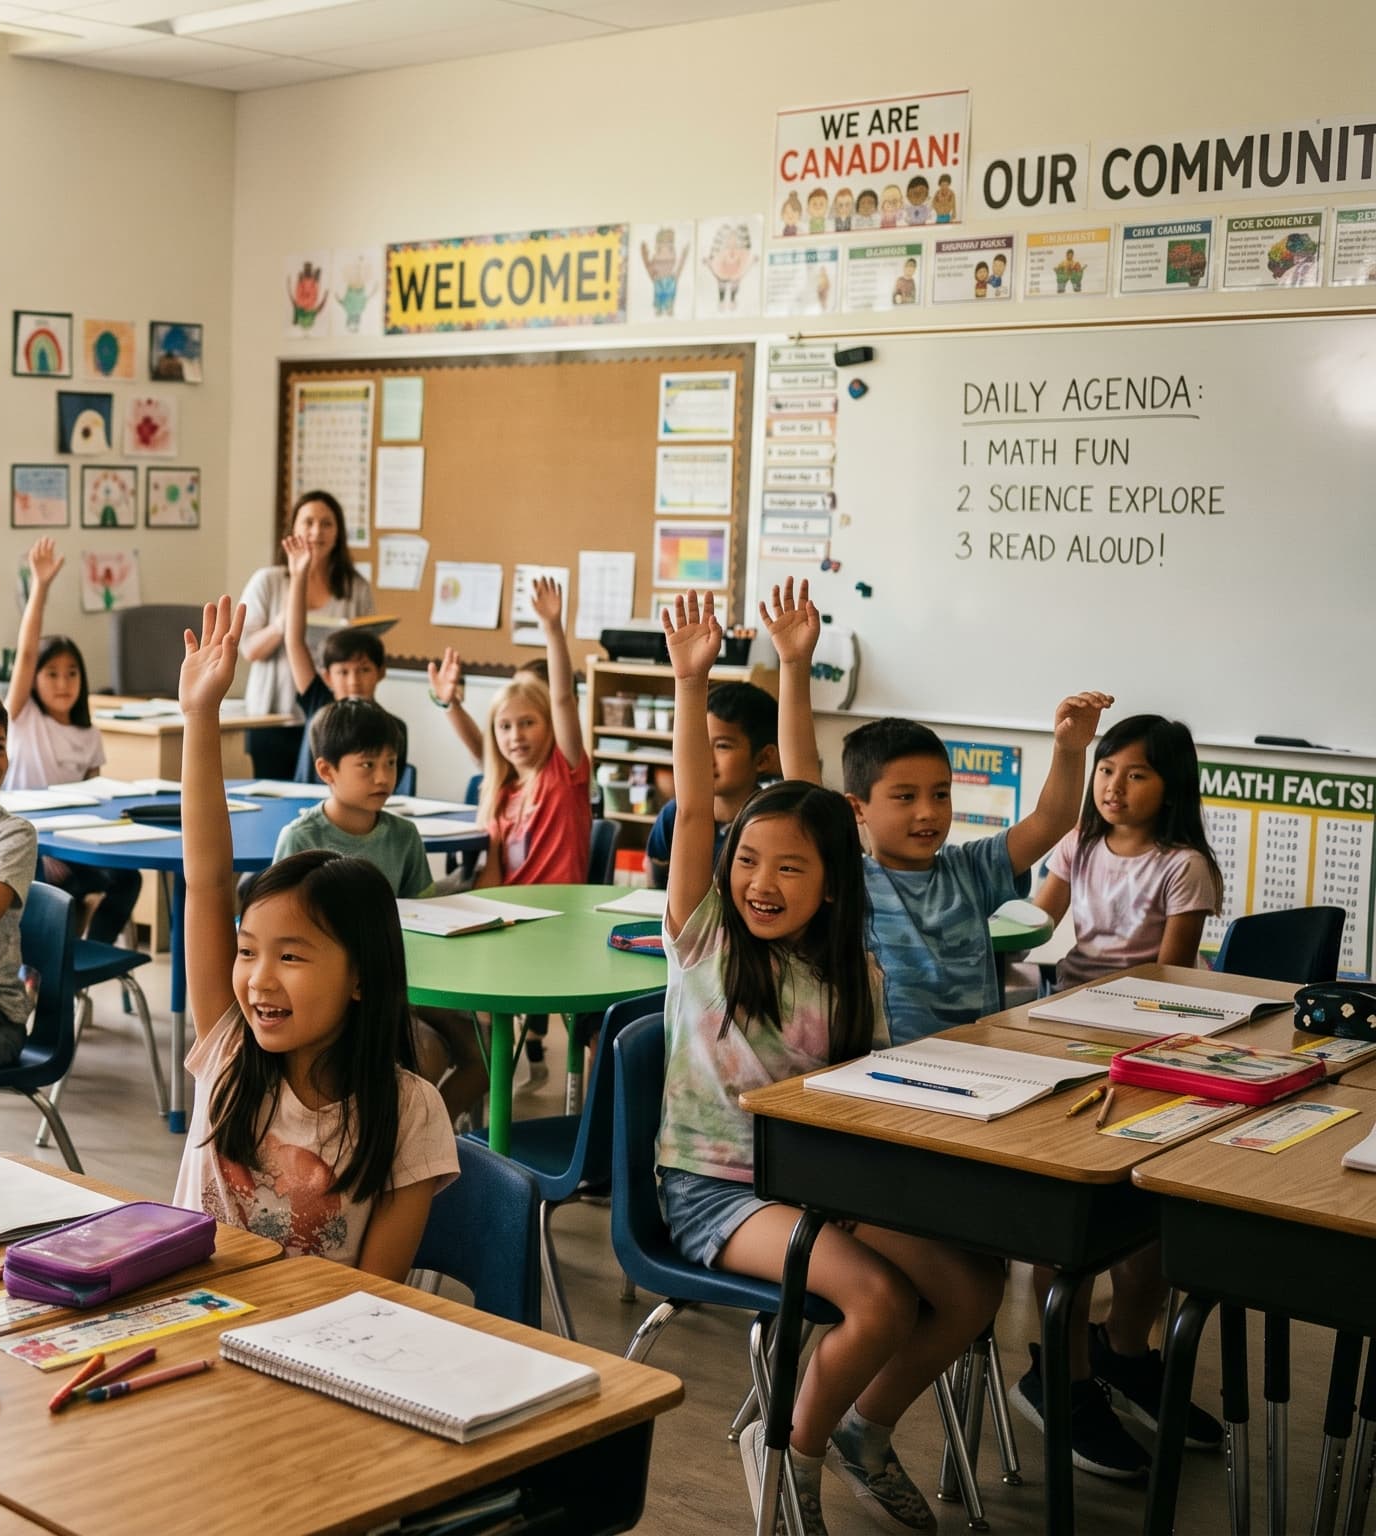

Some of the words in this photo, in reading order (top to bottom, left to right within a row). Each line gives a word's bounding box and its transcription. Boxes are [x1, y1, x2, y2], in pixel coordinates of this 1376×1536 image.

[820, 112, 860, 141] WE
[867, 104, 920, 136] ARE
[779, 132, 960, 182] CANADIAN!
[983, 153, 1077, 210] OUR
[1101, 123, 1376, 200] COMMUNIT
[395, 249, 613, 313] WELCOME!
[963, 380, 1047, 415] DAILY
[1062, 375, 1204, 412] AGENDA:
[987, 438, 1057, 466] MATH
[1075, 437, 1130, 466] FUN
[987, 484, 1095, 513] SCIENCE
[1109, 485, 1225, 515] EXPLORE
[989, 532, 1056, 562] READ
[1066, 532, 1165, 567] ALOUD!
[1199, 767, 1275, 801] MATH
[1282, 775, 1374, 810] FACTS!
